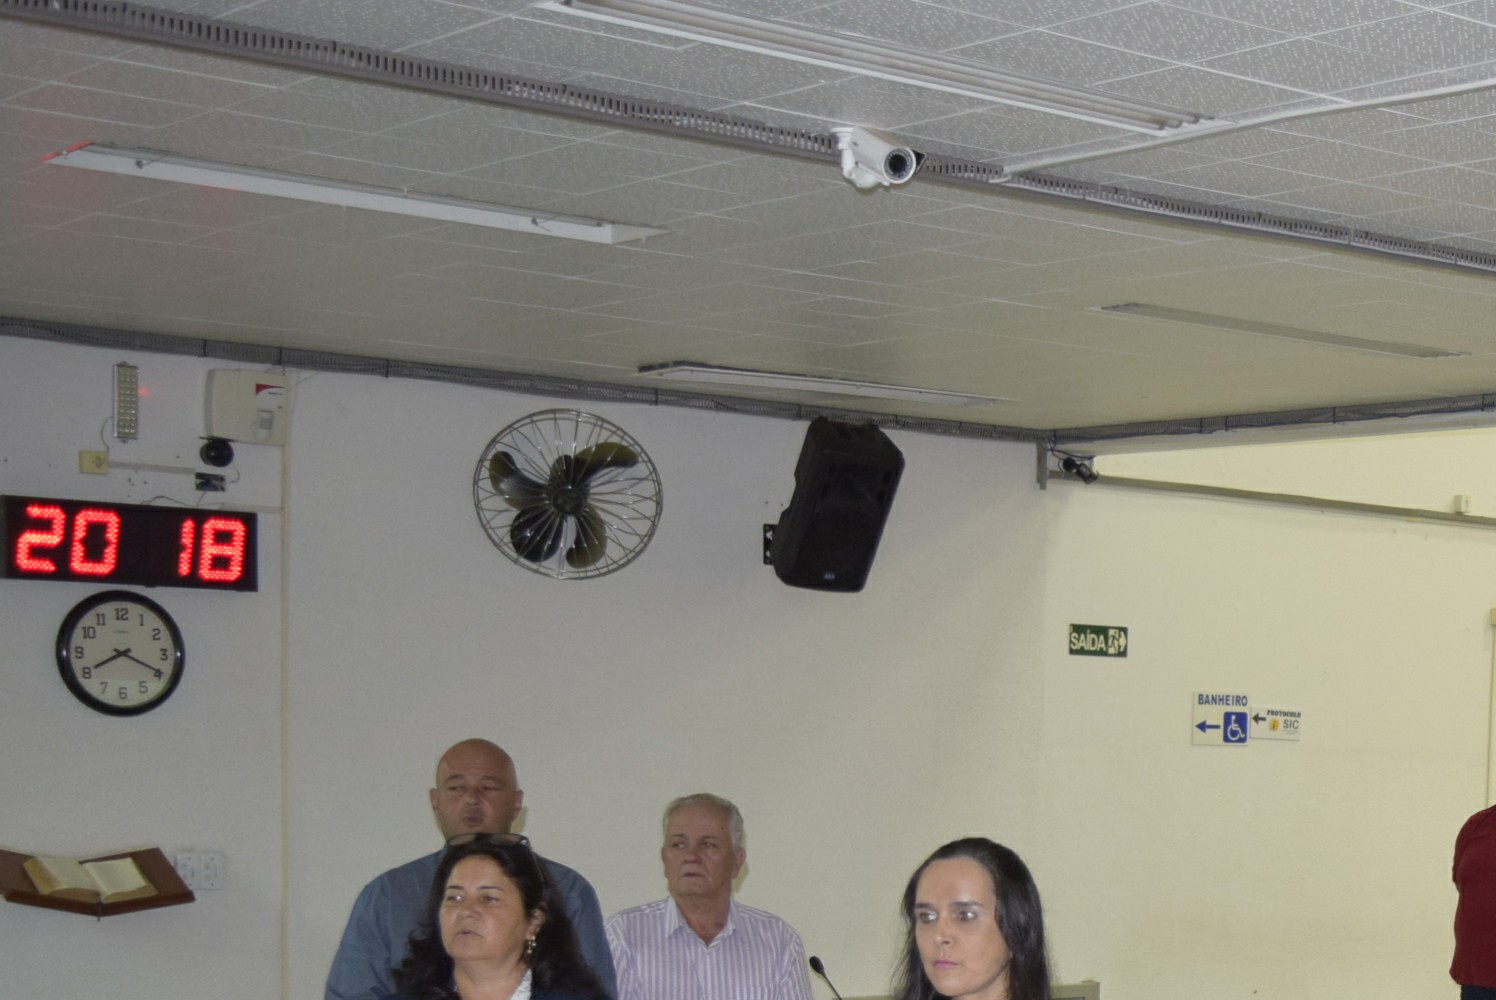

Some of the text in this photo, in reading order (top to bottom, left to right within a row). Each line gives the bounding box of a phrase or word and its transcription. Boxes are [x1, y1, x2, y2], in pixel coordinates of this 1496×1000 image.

[16, 502, 246, 582] 20 18
[95, 613, 106, 626] 11
[114, 607, 129, 621] 12
[139, 613, 145, 627] 1
[82, 626, 96, 639] 10
[152, 628, 161, 641] 2
[1071, 629, 1106, 651] SAÍDA
[75, 646, 84, 659] 9
[160, 648, 169, 661] 3
[82, 666, 92, 679] 8
[100, 682, 108, 695] 7
[119, 687, 128, 700] 6
[139, 681, 148, 694] 5
[1198, 694, 1248, 707] BANHEIRO
[1266, 709, 1302, 718] PROTOCOLO
[1283, 719, 1299, 730] SIC
